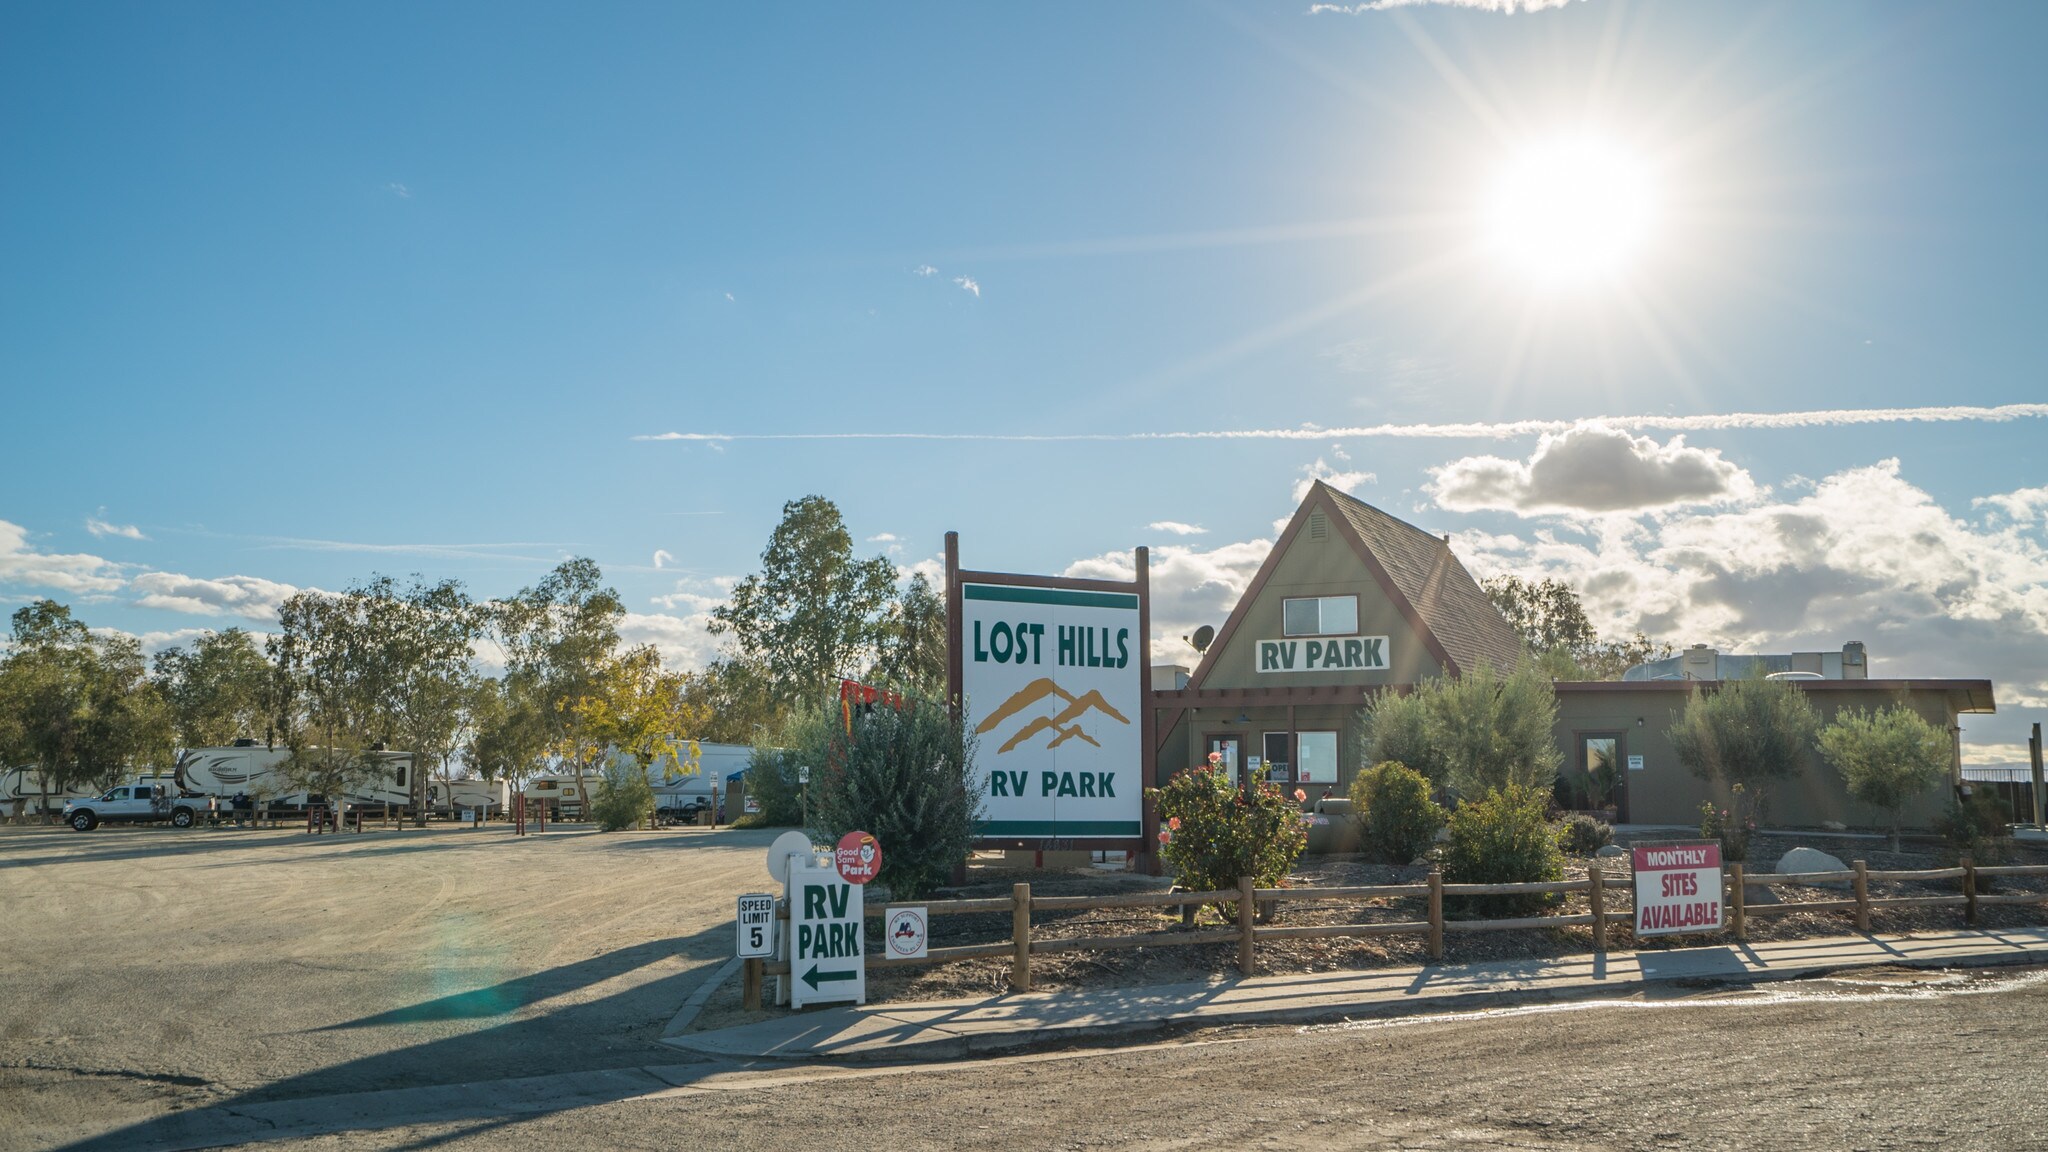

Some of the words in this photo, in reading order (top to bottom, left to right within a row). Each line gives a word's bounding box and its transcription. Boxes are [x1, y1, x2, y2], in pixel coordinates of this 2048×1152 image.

[974, 620, 1045, 665] LOST
[1058, 625, 1129, 669] HILLS
[1261, 641, 1297, 670] RV
[1306, 638, 1383, 669] PARK
[991, 770, 1029, 797] RV
[1041, 771, 1116, 798] PARK
[837, 848, 859, 856] Good
[837, 856, 855, 864] Sam
[1646, 849, 1706, 867] MONTHLY
[842, 863, 872, 875] Park
[1661, 872, 1698, 897] SITES
[741, 899, 771, 912] SPEED
[804, 883, 850, 920] RV
[743, 912, 770, 924] LIMIT
[1640, 901, 1718, 930] AVAILABLE
[750, 927, 763, 949] 5
[799, 922, 859, 960] PARK
